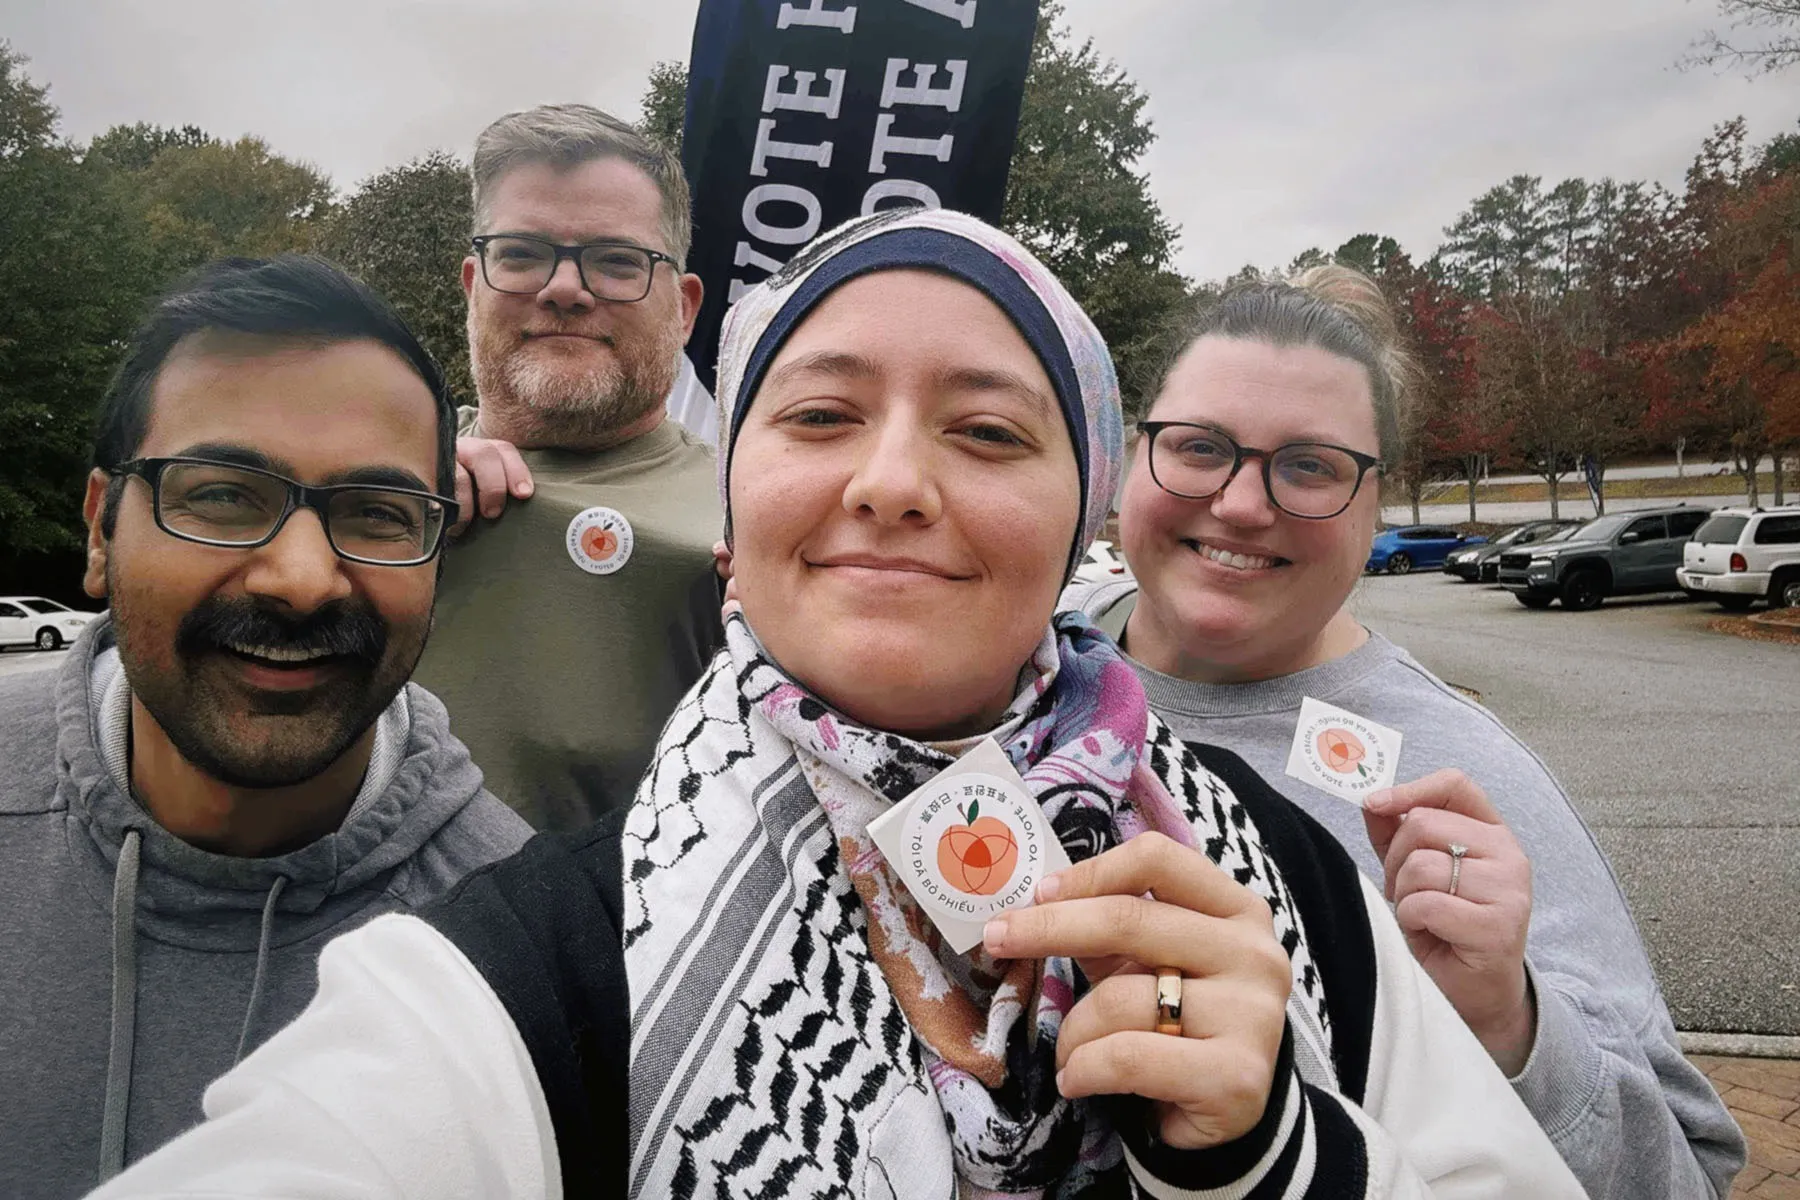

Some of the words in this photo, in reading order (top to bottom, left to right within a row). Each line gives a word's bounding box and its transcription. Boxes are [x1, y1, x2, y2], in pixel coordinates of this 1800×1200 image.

[911, 835, 922, 855] TÔI
[1028, 845, 1038, 862] YO
[997, 875, 1033, 911] VOTED
